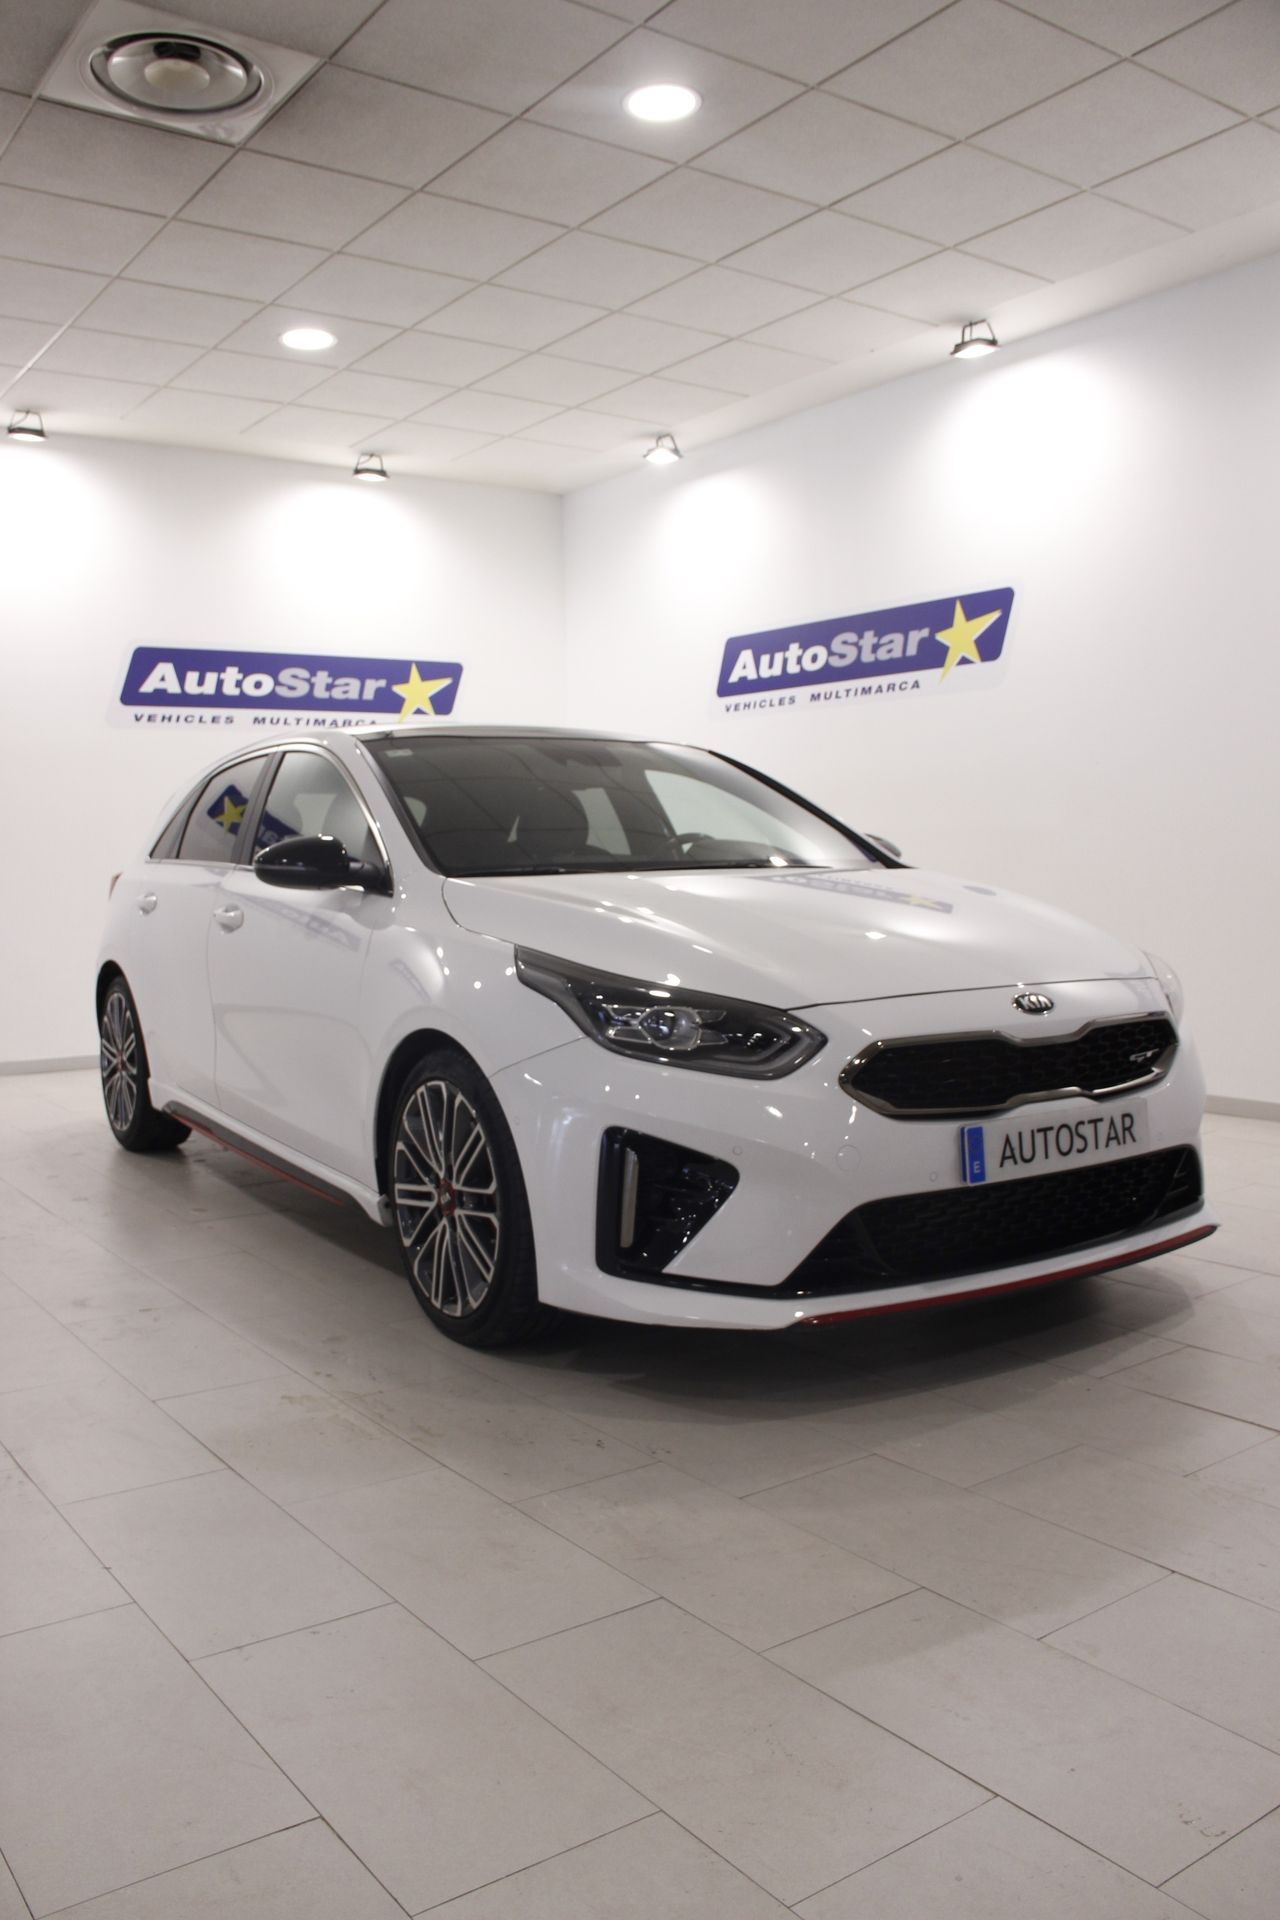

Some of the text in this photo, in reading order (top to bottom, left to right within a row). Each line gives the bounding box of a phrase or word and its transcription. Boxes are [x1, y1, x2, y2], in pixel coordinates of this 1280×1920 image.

[727, 627, 929, 684] AutoStar
[139, 662, 387, 699] AutoStar
[725, 679, 921, 713] VEHICLES MULTIMARCA
[134, 713, 235, 725] VEHICLES
[999, 1112, 1137, 1168] AUTOSTAR
